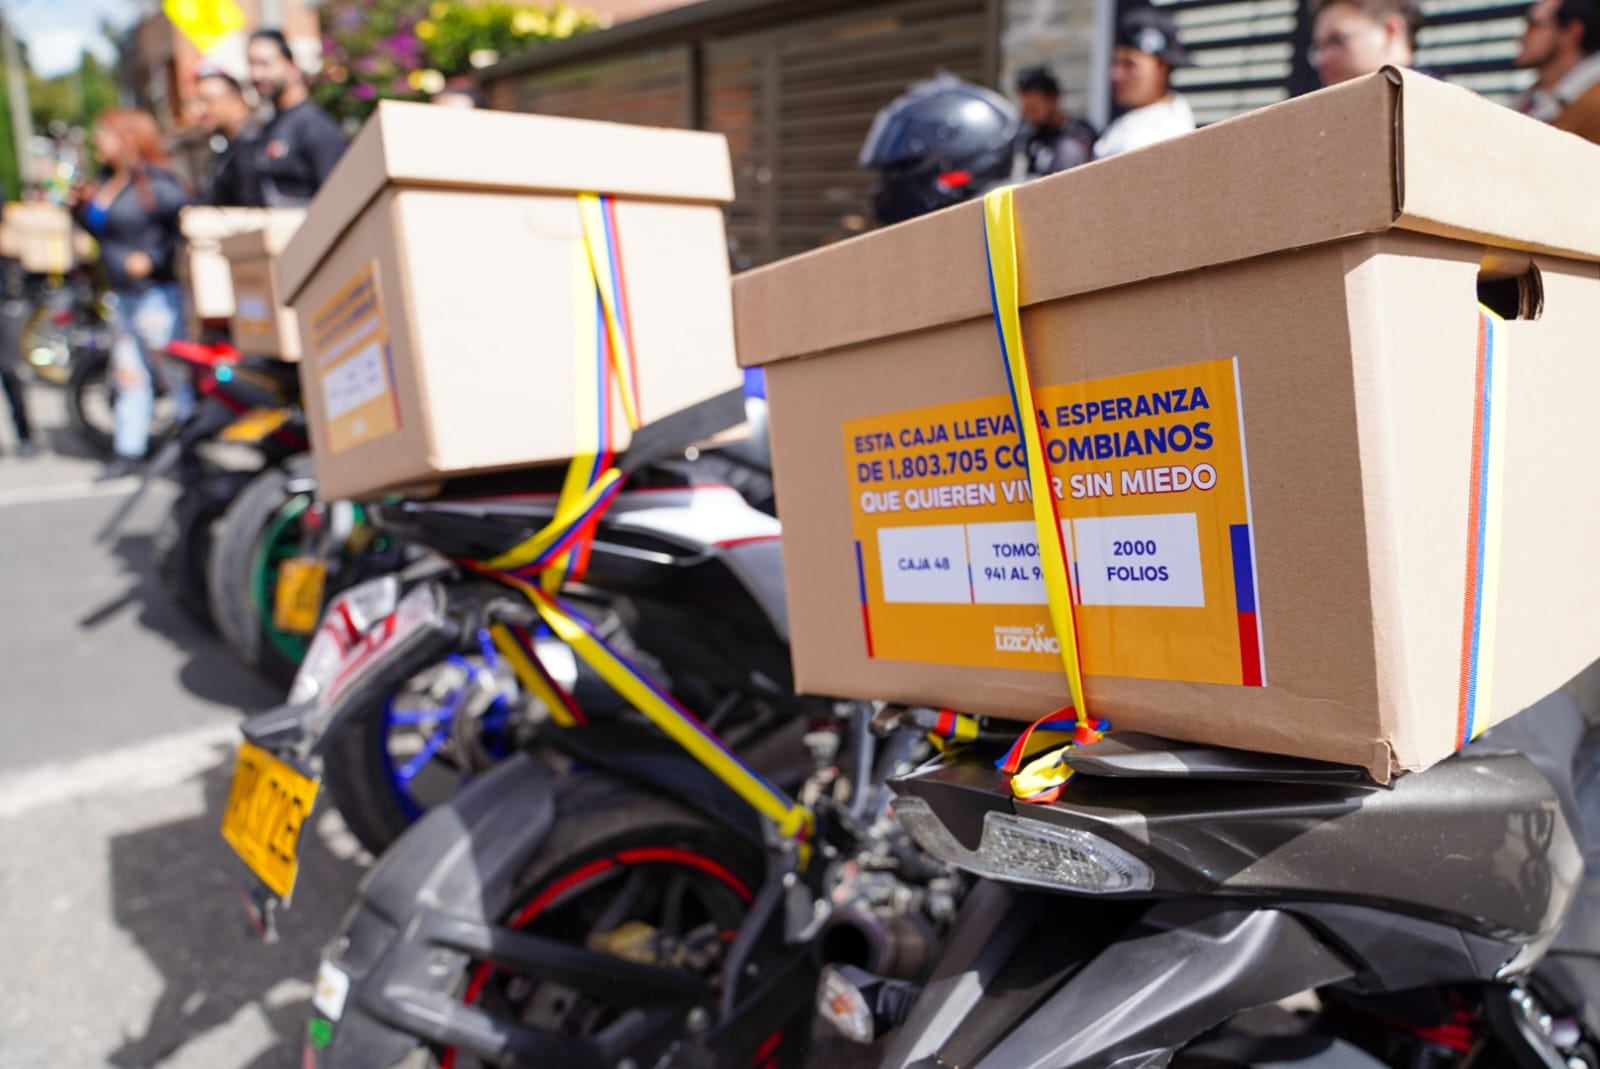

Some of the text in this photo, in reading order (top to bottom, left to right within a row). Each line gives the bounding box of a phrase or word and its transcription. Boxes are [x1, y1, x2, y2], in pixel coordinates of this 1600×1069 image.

[855, 432, 895, 453] ESTA
[900, 424, 949, 447] CAJA
[953, 413, 1016, 440] LLEVA
[1056, 386, 1209, 428] ESPERANZA
[857, 421, 1214, 483] DE 1.803.705 COOMBIANOS
[860, 489, 900, 513] QUE
[904, 482, 996, 510] QUIEREN
[1070, 472, 1114, 499] SIN
[1121, 463, 1217, 496] MIEDO
[1113, 540, 1156, 556] 2000
[898, 556, 950, 571] CAJA 48
[984, 566, 1006, 580] 941
[1010, 566, 1029, 580] AL
[1106, 566, 1169, 581] FOLIOS
